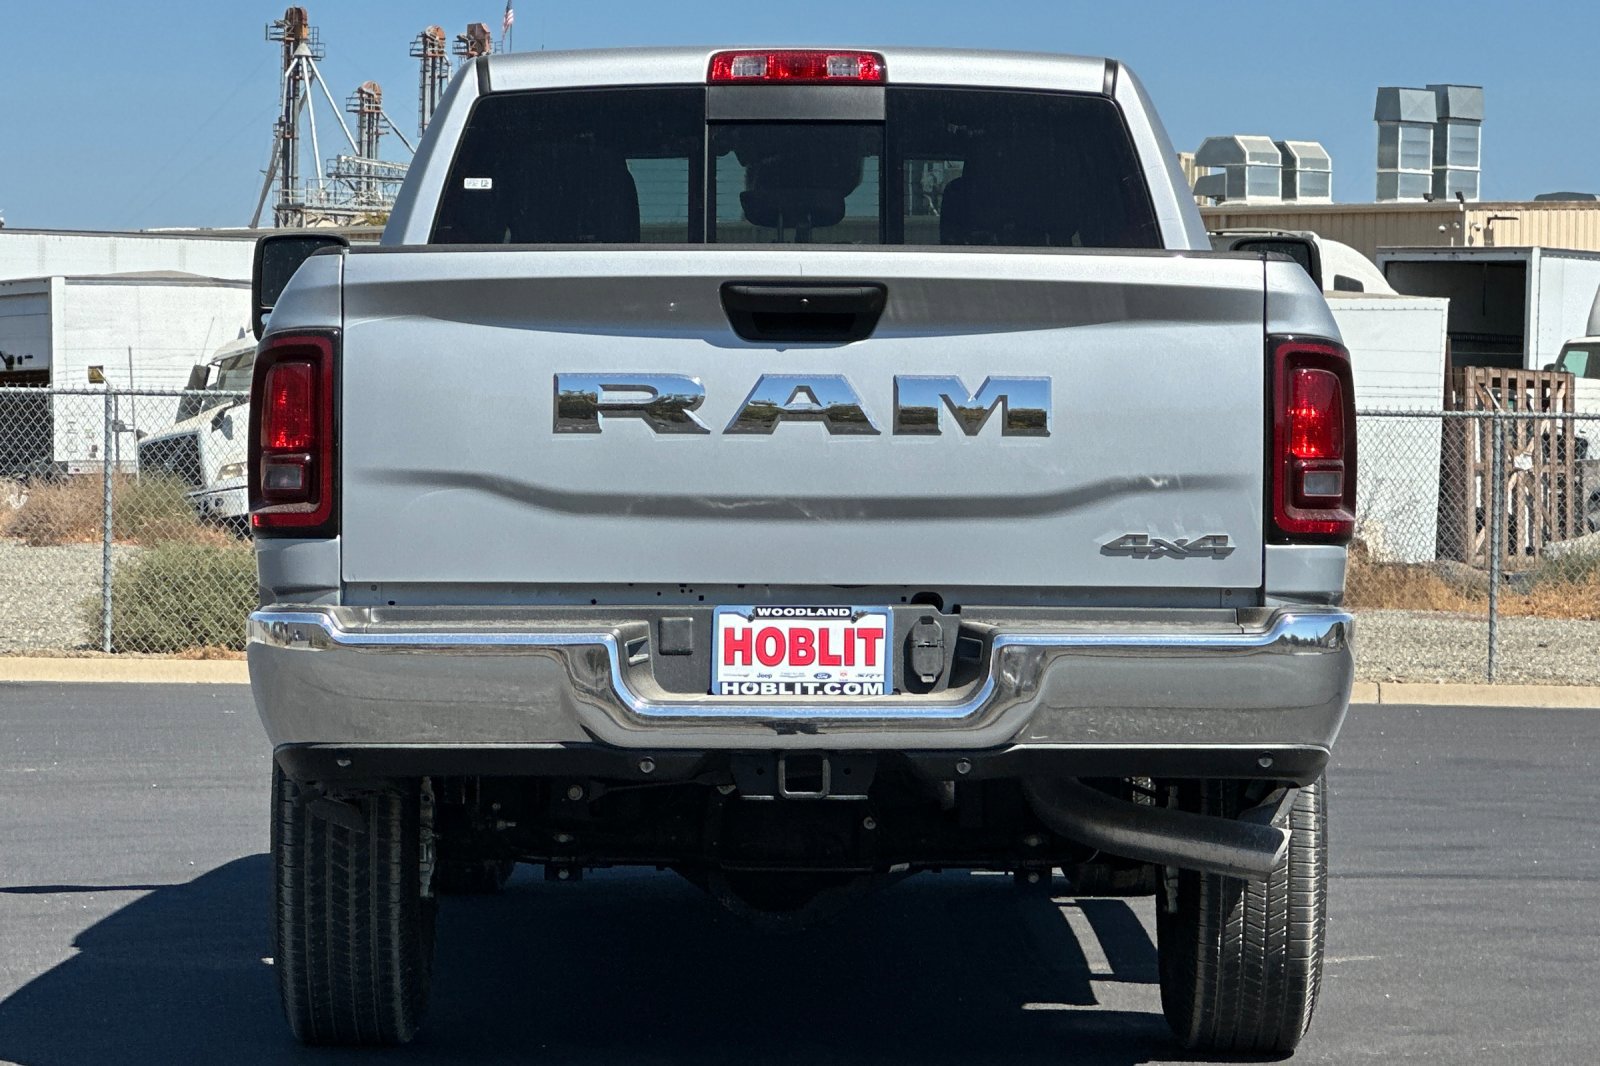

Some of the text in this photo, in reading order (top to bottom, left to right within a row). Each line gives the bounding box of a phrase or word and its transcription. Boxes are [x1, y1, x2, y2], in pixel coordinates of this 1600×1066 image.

[552, 372, 1052, 437] RAM
[1100, 533, 1236, 559] 4x4
[756, 607, 850, 617] WOODLAND
[723, 626, 884, 667] HOBLIT
[721, 682, 884, 695] HOBLIT.COM
